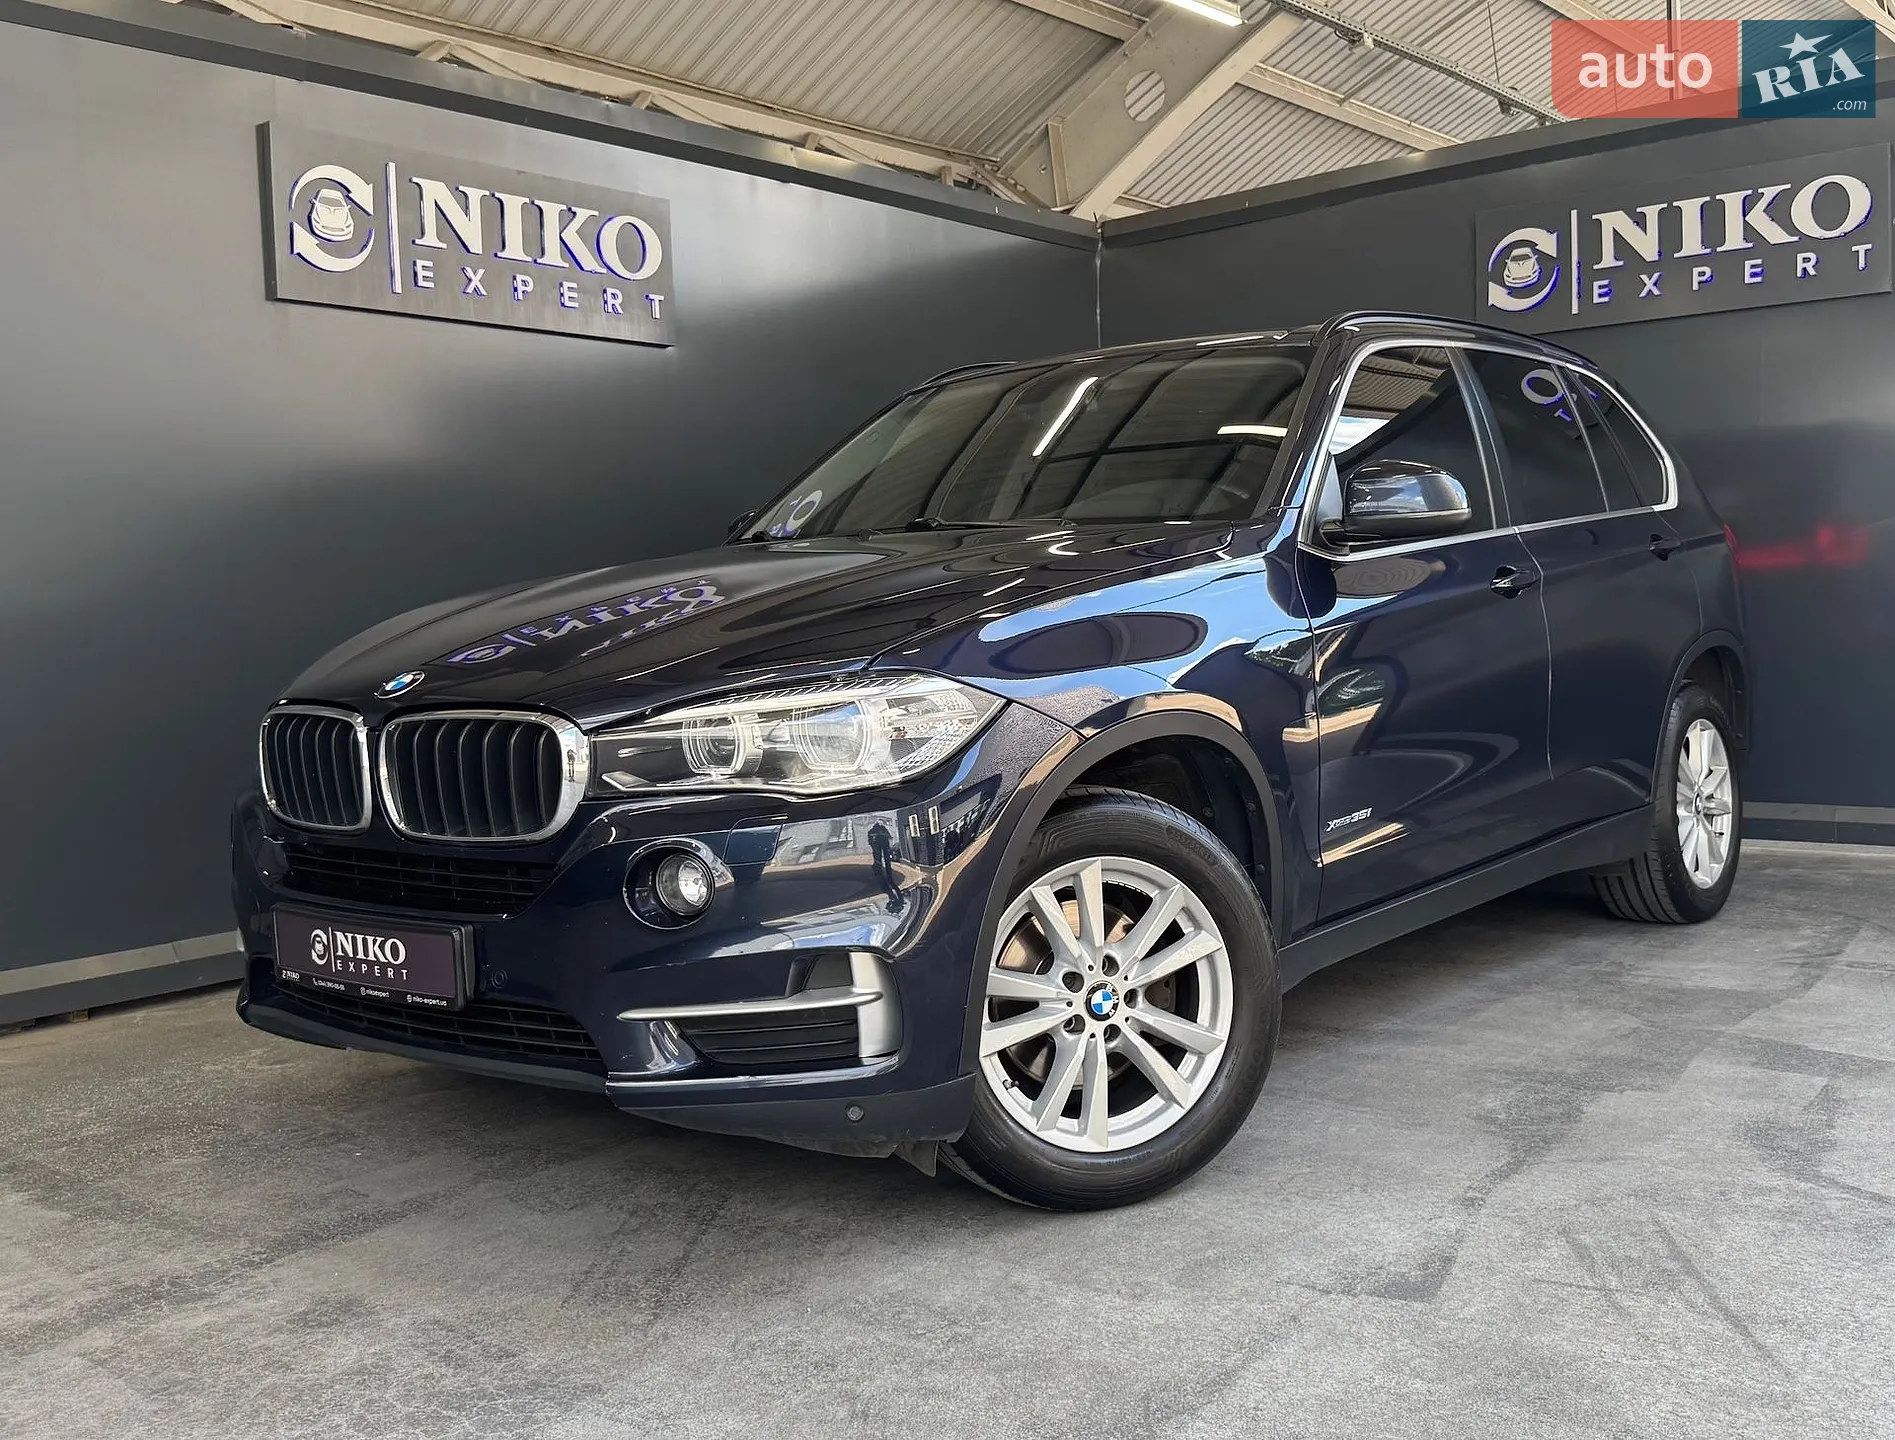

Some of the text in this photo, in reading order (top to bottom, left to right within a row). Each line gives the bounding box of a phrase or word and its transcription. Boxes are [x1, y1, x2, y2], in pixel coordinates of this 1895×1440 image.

[410, 176, 663, 281] NIKO
[1592, 174, 1872, 270] NIKO
[413, 260, 664, 319] EXPERT
[1592, 244, 1872, 304] EXPERT
[333, 931, 407, 965] NIKO
[337, 960, 409, 981] EXPERT
